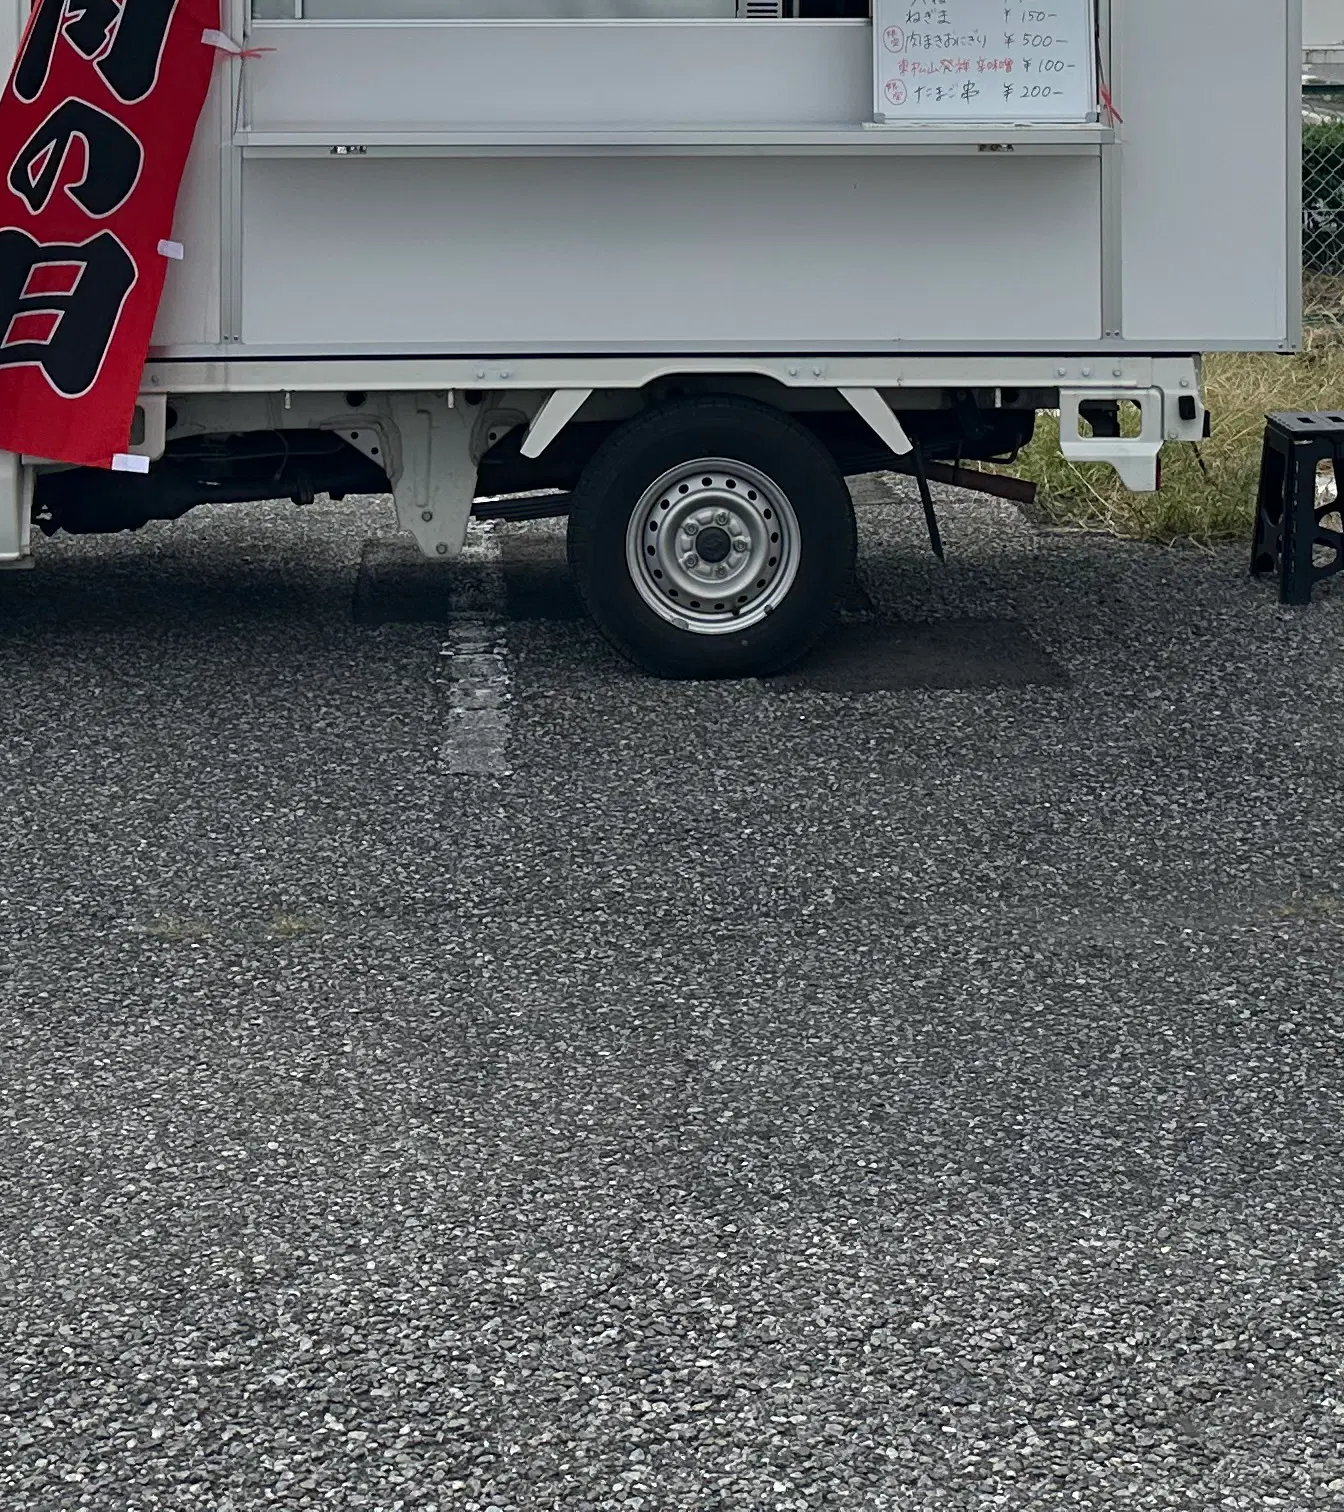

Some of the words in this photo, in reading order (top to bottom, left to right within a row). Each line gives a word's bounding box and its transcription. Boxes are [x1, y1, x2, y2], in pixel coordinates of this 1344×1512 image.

[906, 7, 952, 25] ねぎま
[905, 29, 987, 53] 肉まきおにぎり
[914, 79, 980, 104] たまご串
